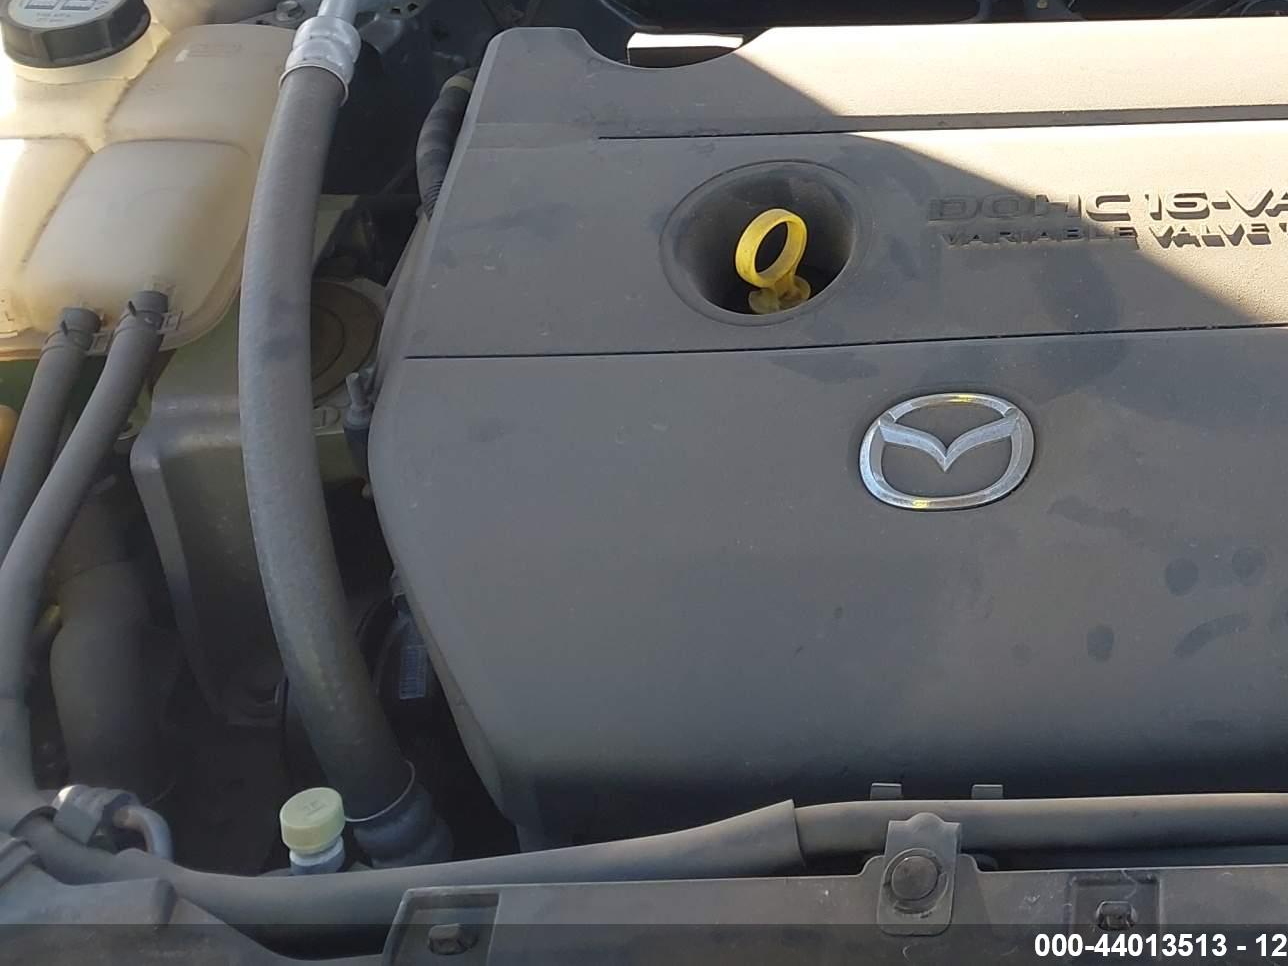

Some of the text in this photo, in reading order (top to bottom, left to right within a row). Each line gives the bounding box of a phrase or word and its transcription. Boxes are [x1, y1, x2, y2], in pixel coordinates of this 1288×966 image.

[929, 193, 1132, 222] DOHC
[941, 226, 1139, 250] VARIABLE
[1150, 223, 1272, 249] VALVE
